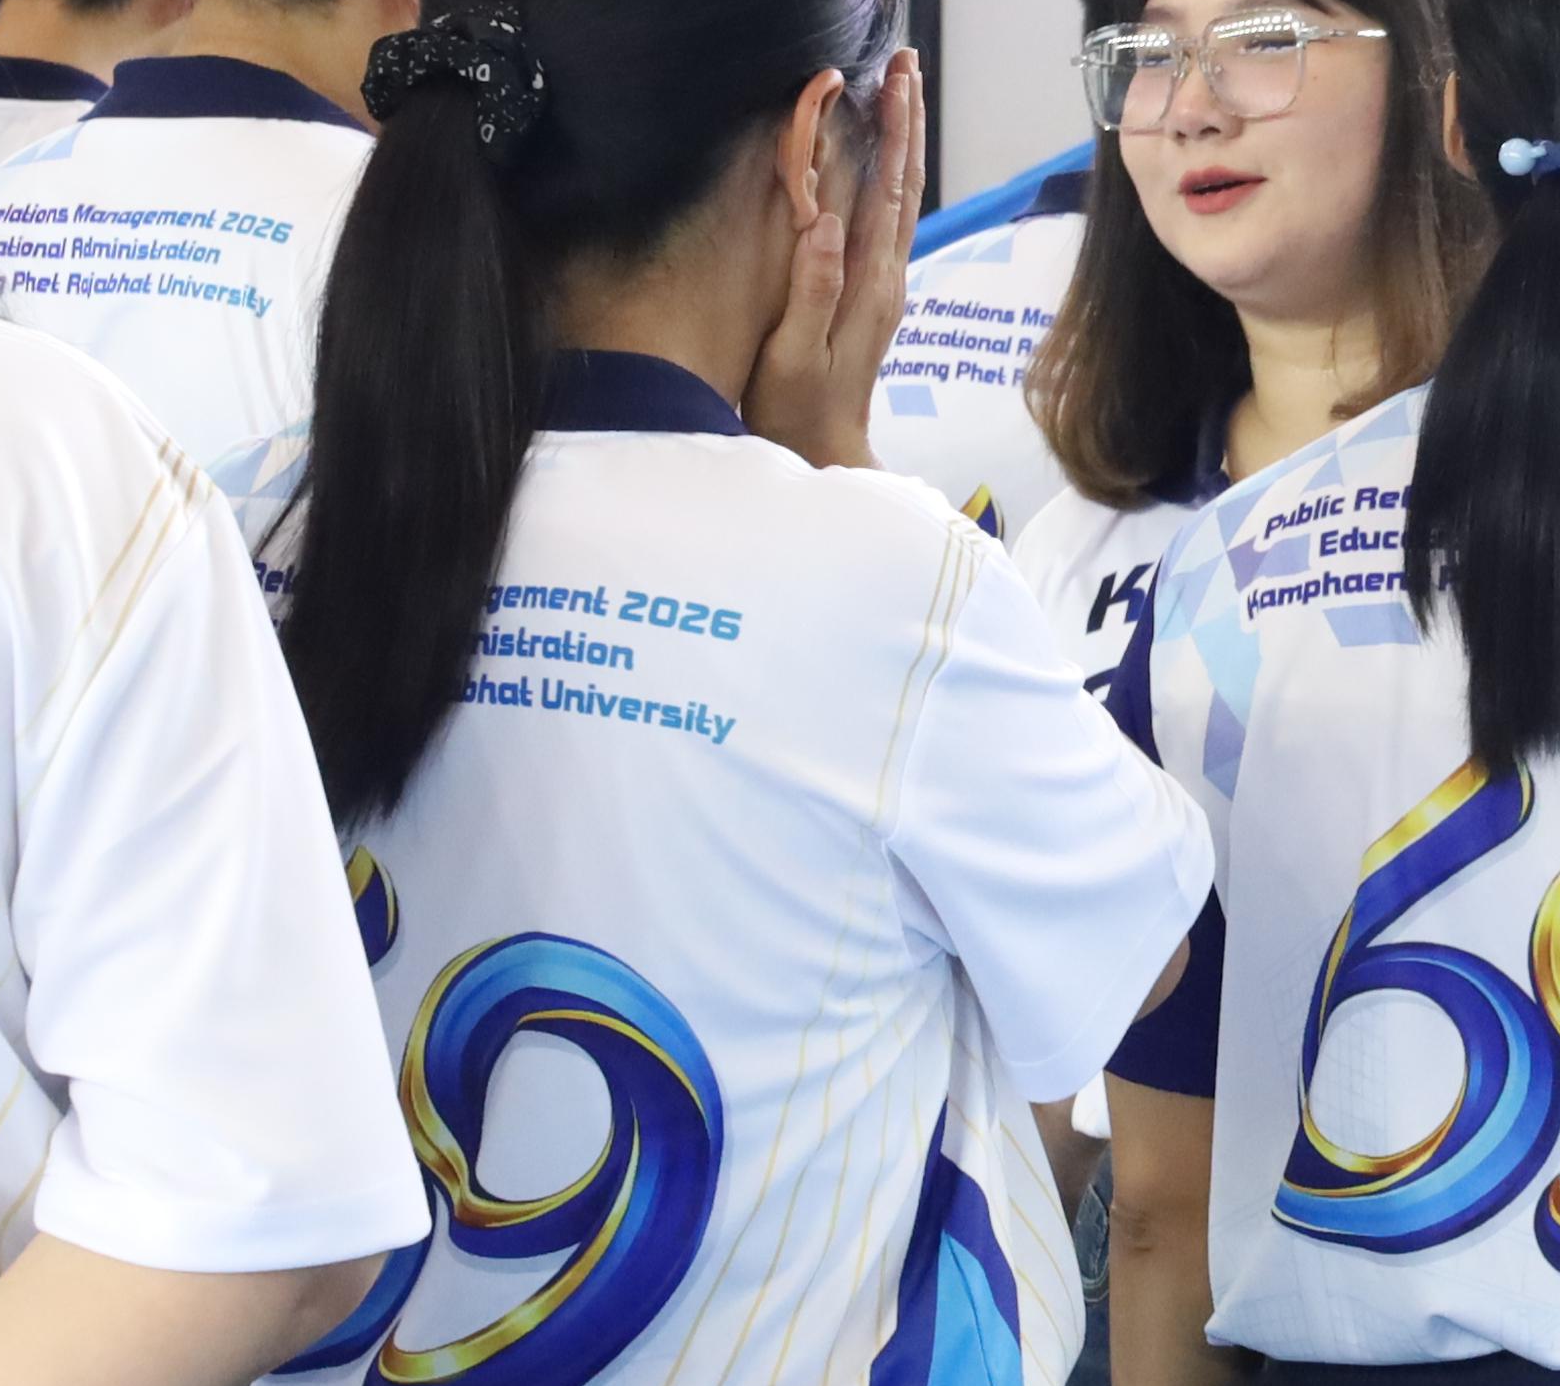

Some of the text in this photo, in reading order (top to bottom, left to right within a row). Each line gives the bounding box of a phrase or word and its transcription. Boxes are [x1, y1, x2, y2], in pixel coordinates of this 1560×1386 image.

[74, 204, 217, 229] Management
[220, 211, 294, 245] 2026
[70, 237, 221, 265] Administration
[11, 271, 60, 295] Phet
[66, 272, 152, 299] Rajabhat
[158, 273, 274, 319] University
[922, 298, 1016, 325] Relations
[895, 327, 1013, 355] Educational
[879, 357, 950, 383] phaeng
[955, 361, 1007, 385] Phet
[1263, 491, 1346, 540] Public
[486, 584, 744, 642] gement 2026
[1246, 570, 1407, 620] Kamphaen
[473, 625, 635, 672] nistration
[541, 676, 737, 746] University
